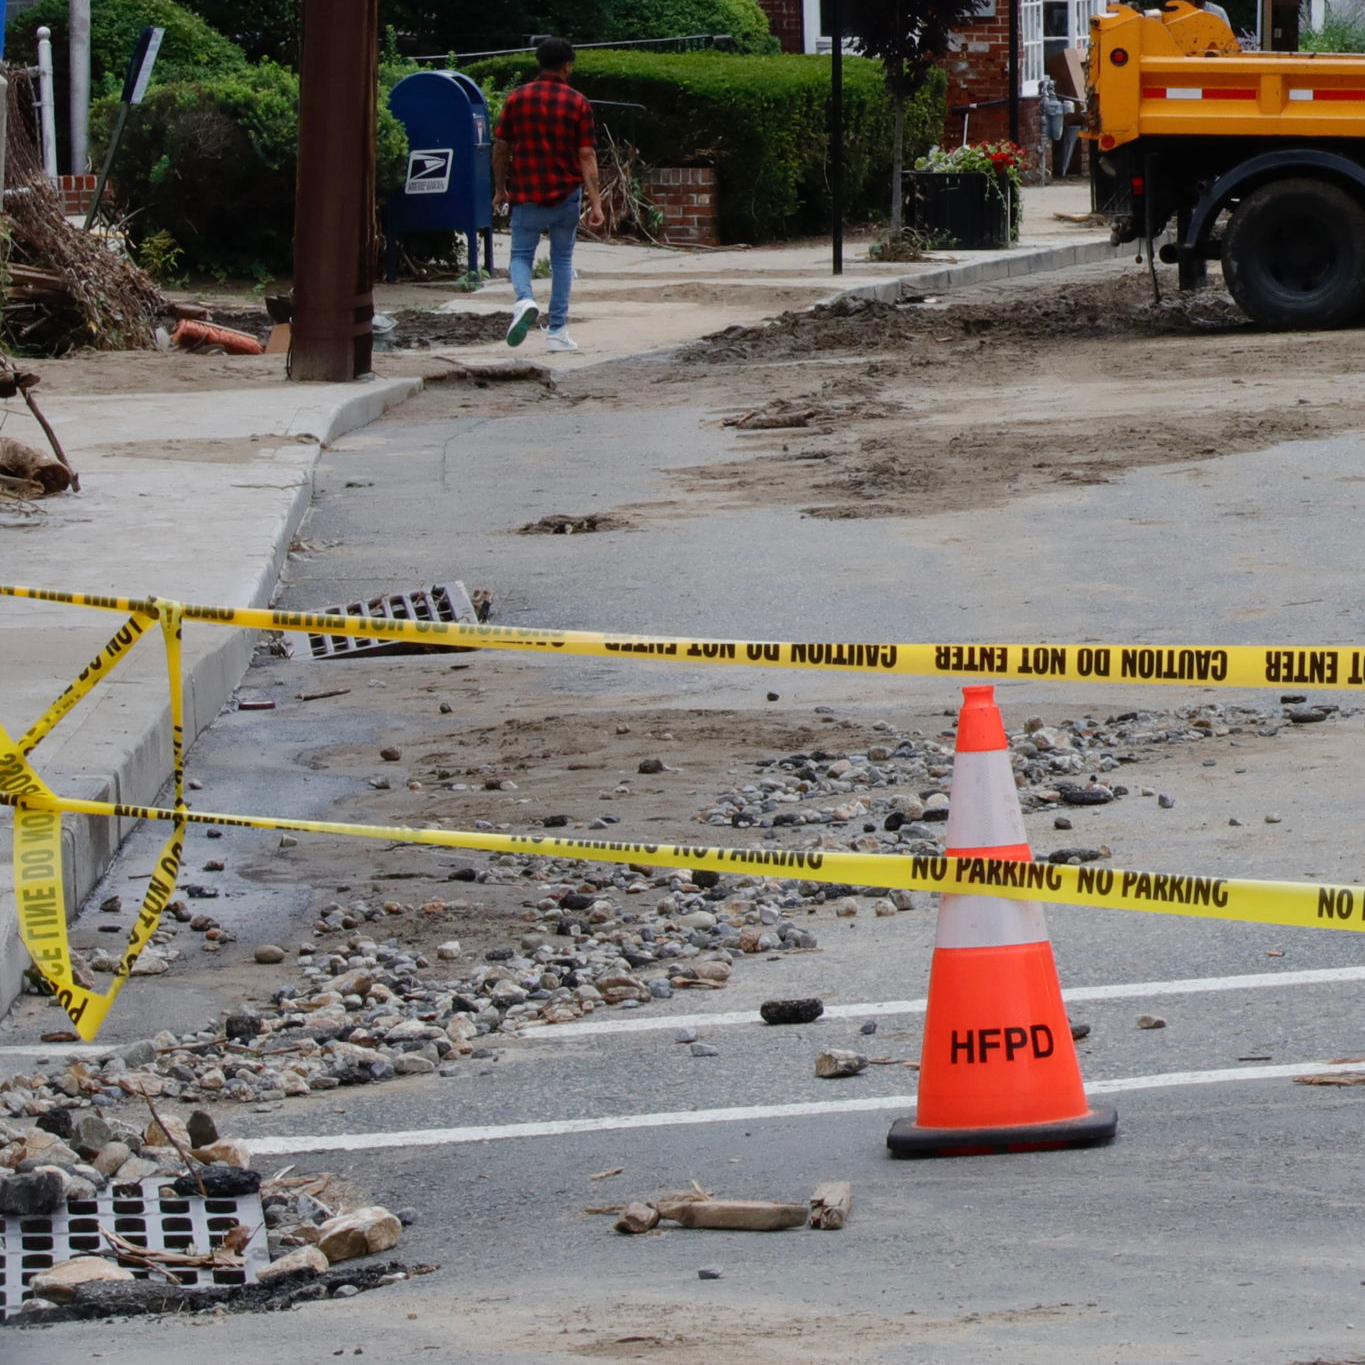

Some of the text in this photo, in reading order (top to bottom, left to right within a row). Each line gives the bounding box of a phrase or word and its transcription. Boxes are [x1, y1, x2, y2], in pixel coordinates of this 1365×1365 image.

[792, 644, 897, 668] CAUTION
[936, 646, 1228, 681] CAUTION DO NOT ENTER
[1265, 651, 1337, 683] ENTER
[911, 857, 1062, 891] NO PARKING
[1077, 867, 1228, 908] NO PARKING
[1318, 887, 1353, 920] NO
[951, 1023, 1054, 1064] HFPD
